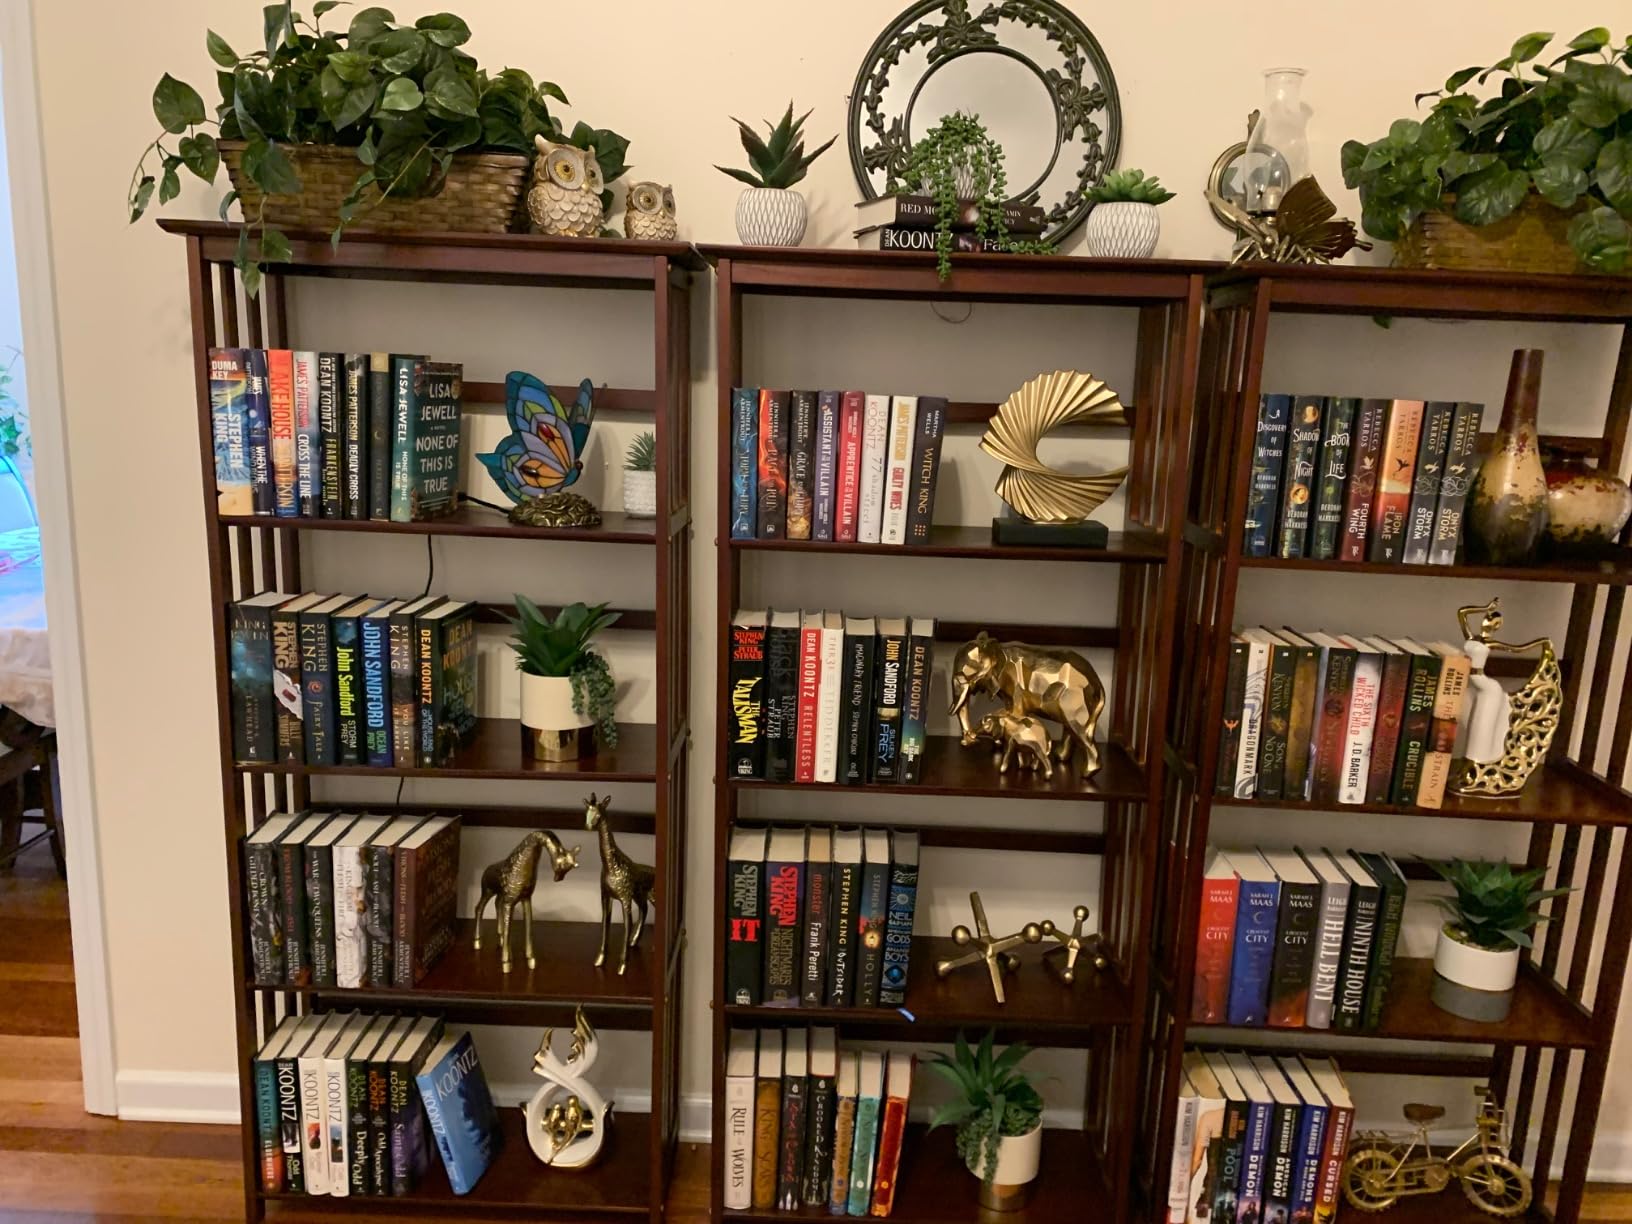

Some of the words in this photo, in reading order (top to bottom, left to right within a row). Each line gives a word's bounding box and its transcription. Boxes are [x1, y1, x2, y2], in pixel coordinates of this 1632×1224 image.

[901, 203, 921, 214] RED
[211, 361, 238, 371] DUMA
[211, 371, 229, 380] KEY
[297, 360, 309, 385] JAMES
[319, 357, 332, 387] DEAN
[398, 368, 408, 395] LISA
[348, 370, 359, 395] JAMES
[214, 413, 229, 442] KING
[273, 403, 292, 440] HOUSE
[320, 390, 333, 433] KOONTZ
[347, 396, 359, 441] PATTERSON
[397, 399, 409, 444] JEWELL
[421, 405, 458, 422] JEWELL
[865, 400, 879, 449] KOONTZ
[924, 412, 933, 435] WELLS
[931, 410, 940, 438] MARTHA
[229, 413, 244, 468] STEPHEN
[416, 436, 444, 453] NONE
[443, 434, 459, 448] OF
[821, 411, 833, 455] ASSISTANT
[1360, 411, 1374, 448] YARROS
[1370, 408, 1385, 452] REBECCA
[1427, 414, 1441, 451] YARROS
[1438, 411, 1452, 455] REBECCA
[1453, 415, 1468, 452] YARROS
[1465, 412, 1480, 456] REBECCA
[255, 446, 267, 470] WHEN
[297, 434, 311, 461] CROSS
[348, 444, 359, 472] DEADLY
[257, 471, 268, 484] THE
[299, 463, 311, 479] THE
[324, 438, 338, 501] FRANKENSTEIN
[420, 457, 443, 472] THIS
[819, 463, 831, 496] VILLAIN
[844, 441, 857, 488] APPRENTICE
[871, 456, 883, 474] 77
[920, 447, 935, 484] WITCH
[1326, 460, 1346, 480] LIFE
[299, 480, 312, 499] LINE
[349, 475, 359, 501] CROSS
[423, 476, 449, 495] TRUE
[917, 488, 930, 514] KING
[842, 493, 853, 525] VILLAIN
[1348, 508, 1361, 534] WING
[1356, 503, 1371, 539] FOURTH
[1381, 505, 1395, 541] FLAME
[1391, 512, 1404, 534] IRON
[1412, 507, 1427, 540] STORM
[1421, 511, 1434, 538] ONYX
[1437, 508, 1452, 541] STORM
[1449, 512, 1461, 539] ONYX
[274, 622, 289, 669] KING
[288, 621, 299, 669] STEPHEN
[301, 624, 316, 672] KING
[316, 623, 328, 672] STEPHEN
[362, 622, 381, 658] JOHN
[389, 625, 401, 670] KING
[401, 625, 409, 670] STEPHEN
[420, 629, 433, 659] DEAN
[805, 632, 817, 653] DEAN
[886, 639, 902, 660] JOHN
[337, 647, 354, 671] John
[913, 646, 926, 675] DEAN
[421, 662, 433, 704] KOONTZ
[803, 656, 818, 698] KOONTZ
[851, 680, 863, 706] FRIEND
[883, 662, 900, 705] SANDFORD
[1353, 677, 1368, 709] WICKED
[1364, 684, 1376, 702] THE
[1409, 669, 1428, 712] ROLLINS
[1422, 675, 1438, 708] JAMES
[1452, 671, 1465, 696] JAMES
[338, 674, 356, 716] Sandford
[365, 661, 385, 728] SANDFORD
[732, 677, 762, 744] TALISMAN
[750, 701, 761, 717] THE
[909, 679, 923, 720] KOONTZ
[402, 709, 410, 726] YOU
[766, 698, 776, 739] STRAUB
[1350, 711, 1364, 736] CHILD
[1360, 703, 1374, 728] SIXTH
[340, 723, 349, 745] PREY
[347, 720, 357, 748] STORM
[376, 730, 387, 754] OCEAN
[402, 731, 410, 751] LIKE
[801, 705, 814, 767] RELENTLESS
[878, 723, 890, 763] PREY
[889, 729, 897, 758] SILKEN
[1242, 719, 1259, 775] DRAGONMARK
[1347, 758, 1361, 788] BARKER
[1402, 741, 1422, 790] CRUCIBLE
[1429, 752, 1445, 790] STRAIN
[312, 860, 321, 880] WAR
[733, 873, 747, 907] KING
[741, 865, 759, 916] STEPHEN
[769, 876, 785, 916] KING
[778, 866, 799, 926] STEPHEN
[811, 874, 823, 914] monster
[841, 868, 852, 915] STEPHEN
[1210, 896, 1233, 904] MAAS
[1249, 898, 1274, 907] MAAS
[1290, 899, 1314, 908] MAAS
[731, 920, 760, 942] IT
[809, 922, 822, 949] Frank
[837, 919, 848, 946] KING
[887, 932, 912, 944] GODS
[1205, 930, 1229, 941] CITY
[1245, 934, 1270, 943] CITY
[1284, 935, 1308, 945] CITY
[1320, 919, 1345, 959] HELL
[1349, 919, 1375, 964] NINTH
[808, 950, 820, 981] Peretti
[862, 953, 877, 995] HOLLY
[1313, 962, 1338, 1002] BENT
[1341, 968, 1368, 1015] HOUSE
[434, 1045, 478, 1102] KOONTZ
[278, 1066, 298, 1121] KOONTZ
[303, 1073, 321, 1121] KOONTZ
[327, 1075, 343, 1122] KOONTZ
[369, 1071, 380, 1111] KOONTZ
[390, 1070, 400, 1113] KOONTZ
[398, 1080, 408, 1106] DEAN
[422, 1092, 447, 1134] KOONTZ
[731, 1107, 748, 1137] RULE
[1283, 1108, 1293, 1121] KIM
[1312, 1110, 1322, 1123] KIM
[1337, 1111, 1347, 1124] KIM
[354, 1131, 368, 1165] Deeply
[1252, 1119, 1263, 1151] HARRISON
[1279, 1122, 1291, 1154] HARRISON
[1306, 1123, 1320, 1155] HARRISON
[1331, 1124, 1345, 1157] HARRISON
[351, 1164, 362, 1185] Odd
[732, 1148, 750, 1189] WOLVES
[1245, 1155, 1259, 1197] DEMON
[1272, 1156, 1286, 1197] DEMON
[1281, 1158, 1292, 1197] AMERICAN
[1304, 1159, 1319, 1203] DEMONS
[1322, 1159, 1339, 1203] CURSED
